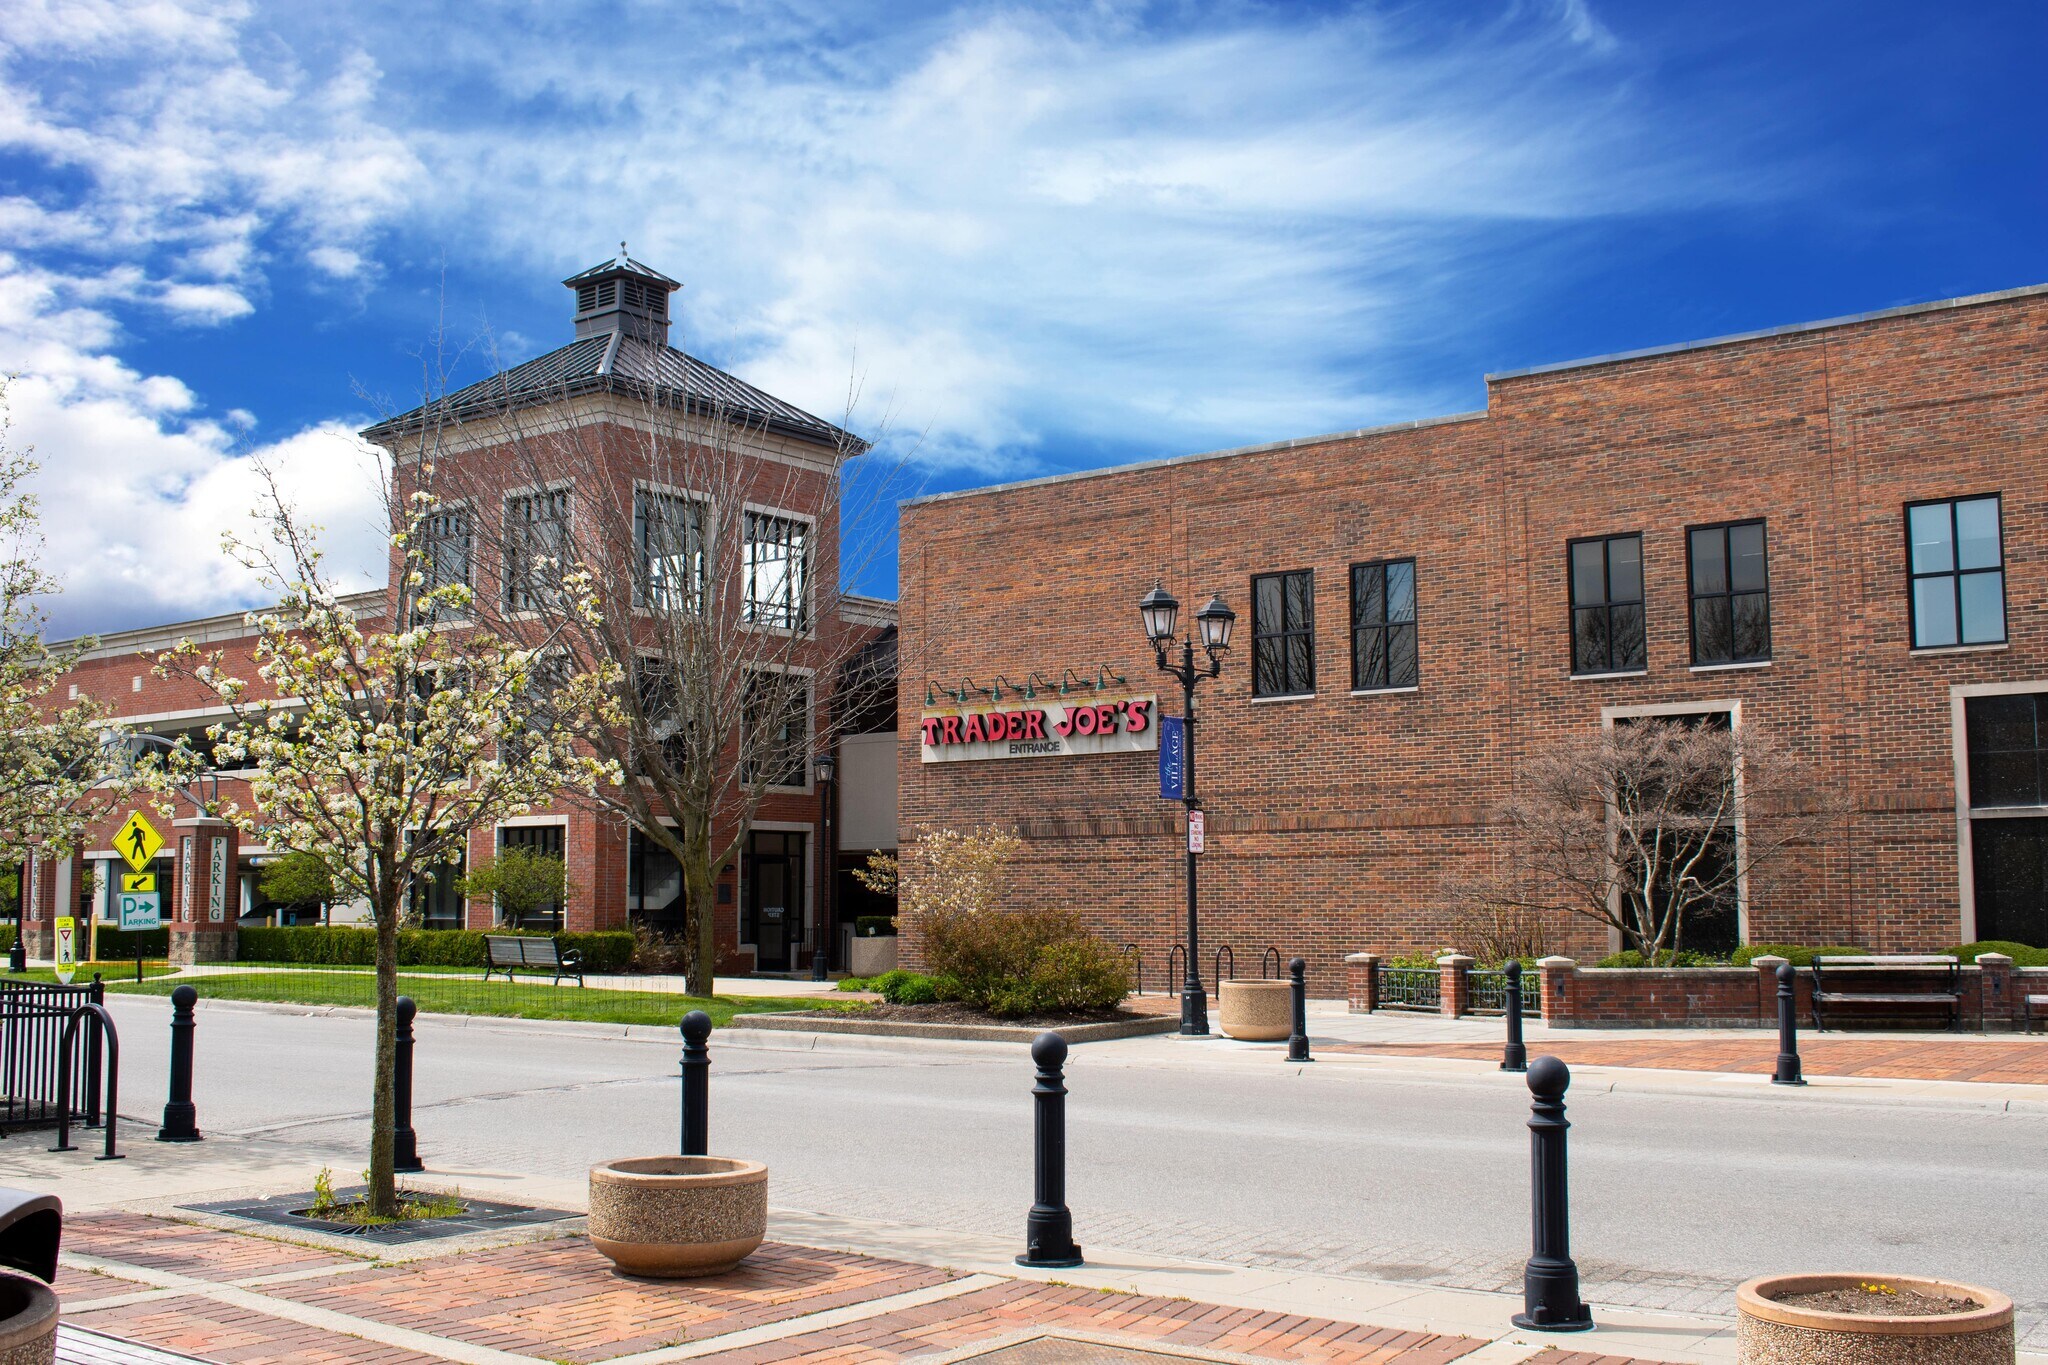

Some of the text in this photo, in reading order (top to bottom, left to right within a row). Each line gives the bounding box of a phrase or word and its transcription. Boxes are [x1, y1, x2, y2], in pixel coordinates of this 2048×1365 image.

[921, 700, 1151, 745] TRADER JOE'S
[1009, 741, 1060, 754] ENTRANCE
[1171, 730, 1179, 789] VILLAGE
[211, 838, 222, 919] PARKING
